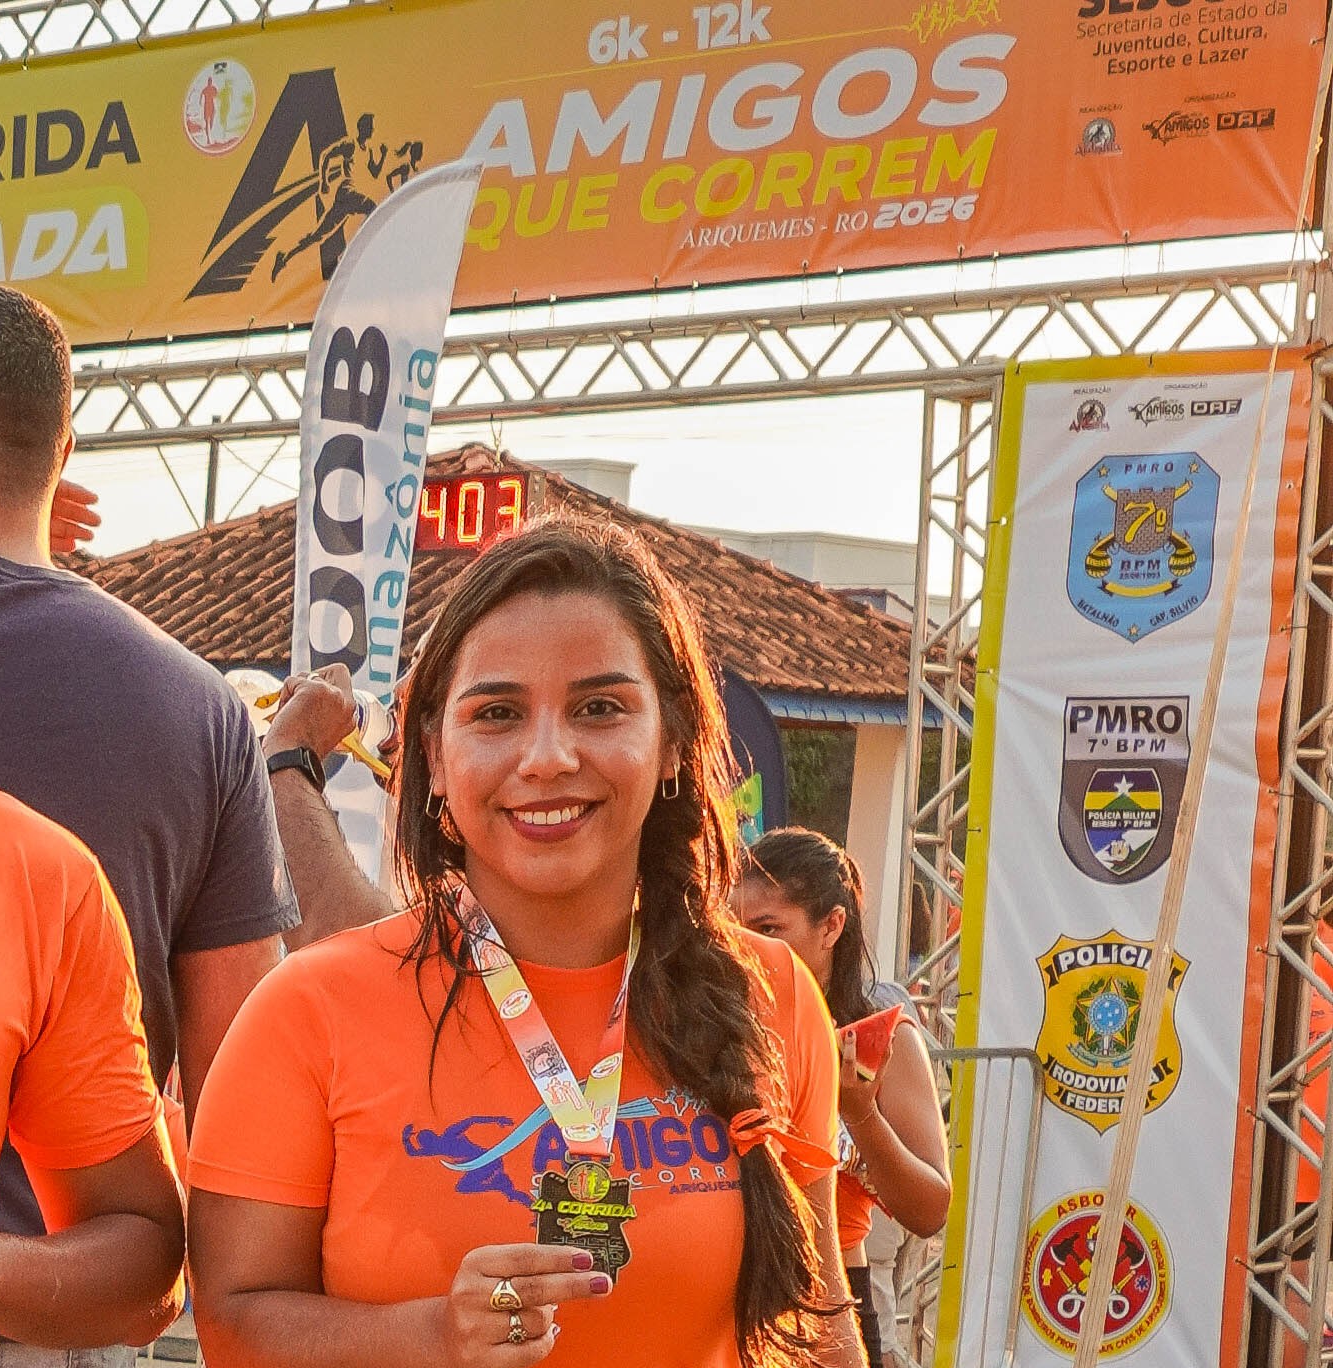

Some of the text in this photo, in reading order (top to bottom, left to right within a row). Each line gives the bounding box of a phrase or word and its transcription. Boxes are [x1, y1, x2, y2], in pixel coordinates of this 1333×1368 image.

[1077, 14, 1163, 40] Secretaria
[1169, 11, 1192, 28] de
[1198, 4, 1258, 26] Estado
[1265, 0, 1288, 17] da
[588, 17, 649, 67] 6k
[693, 3, 774, 52] 12k
[1093, 25, 1269, 57] Juventude, Cultura,
[1108, 47, 1250, 75] Esporte e Lazer
[460, 34, 1018, 178] AMIGOS
[465, 129, 999, 252] QUE CORREM
[681, 217, 814, 251] ARIQUEMES
[834, 210, 869, 235] RO
[873, 195, 979, 231] 2026
[1146, 402, 1185, 417] AMIGOS
[1124, 463, 1174, 474] PMRO
[1123, 500, 1167, 544] 7º
[1120, 559, 1161, 571] BPM
[1077, 599, 1120, 627] BATALHÃO
[1069, 705, 1183, 734] PMRO
[1087, 738, 1166, 753] 7º BPM
[1088, 811, 1156, 820] POLÍCIA MILITAR
[1065, 1092, 1124, 1113] FEDER
[629, 1165, 728, 1186] CORR
[557, 1200, 637, 1218] CORRIDA
[1056, 1193, 1137, 1220] ASBOR
